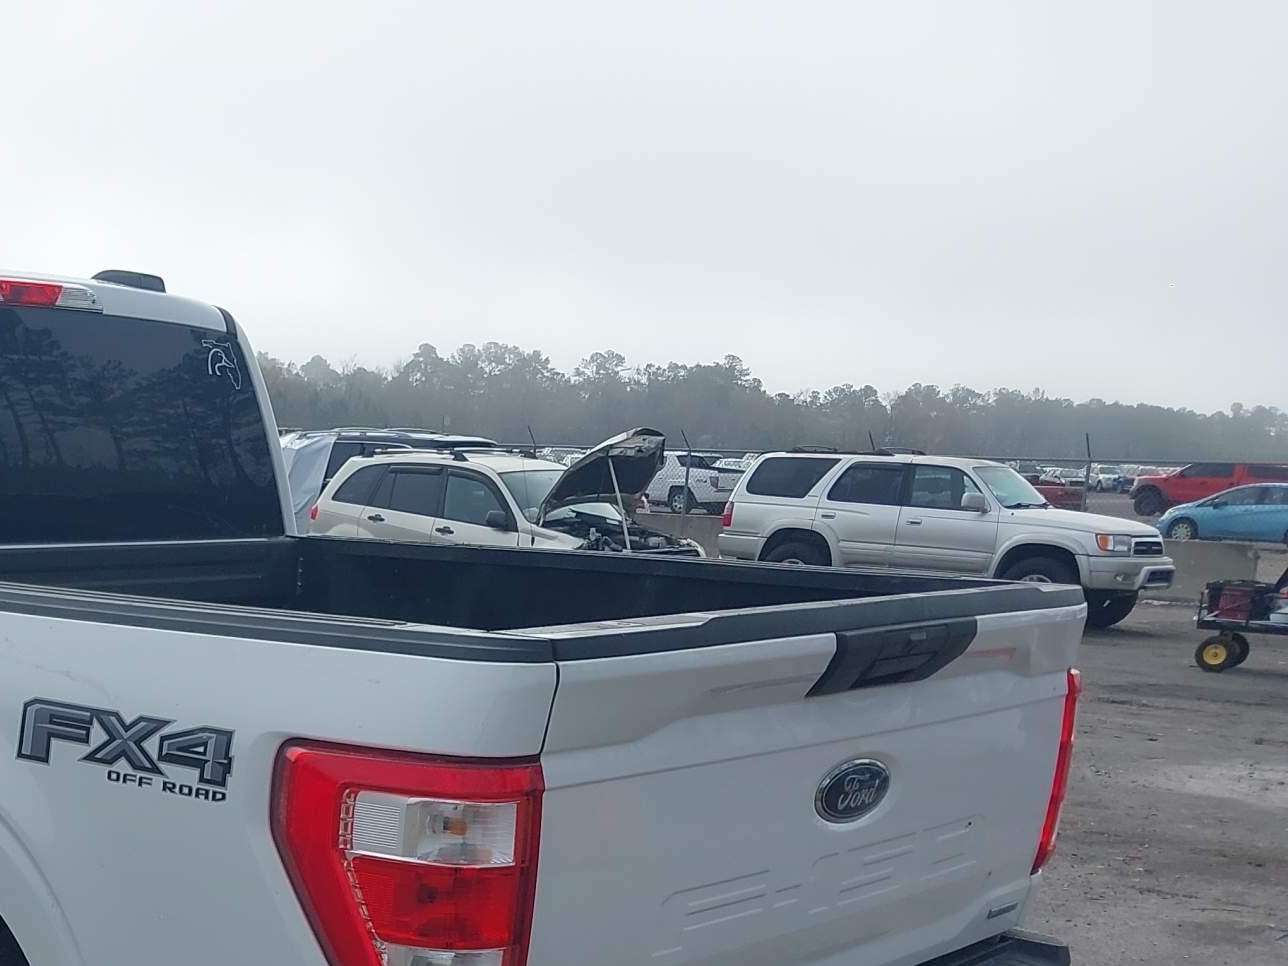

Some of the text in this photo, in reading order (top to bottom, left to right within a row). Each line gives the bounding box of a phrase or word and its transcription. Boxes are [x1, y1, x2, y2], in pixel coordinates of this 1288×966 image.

[16, 697, 235, 788] FX4
[107, 770, 227, 803] OFF ROAD
[837, 774, 879, 810] Ford
